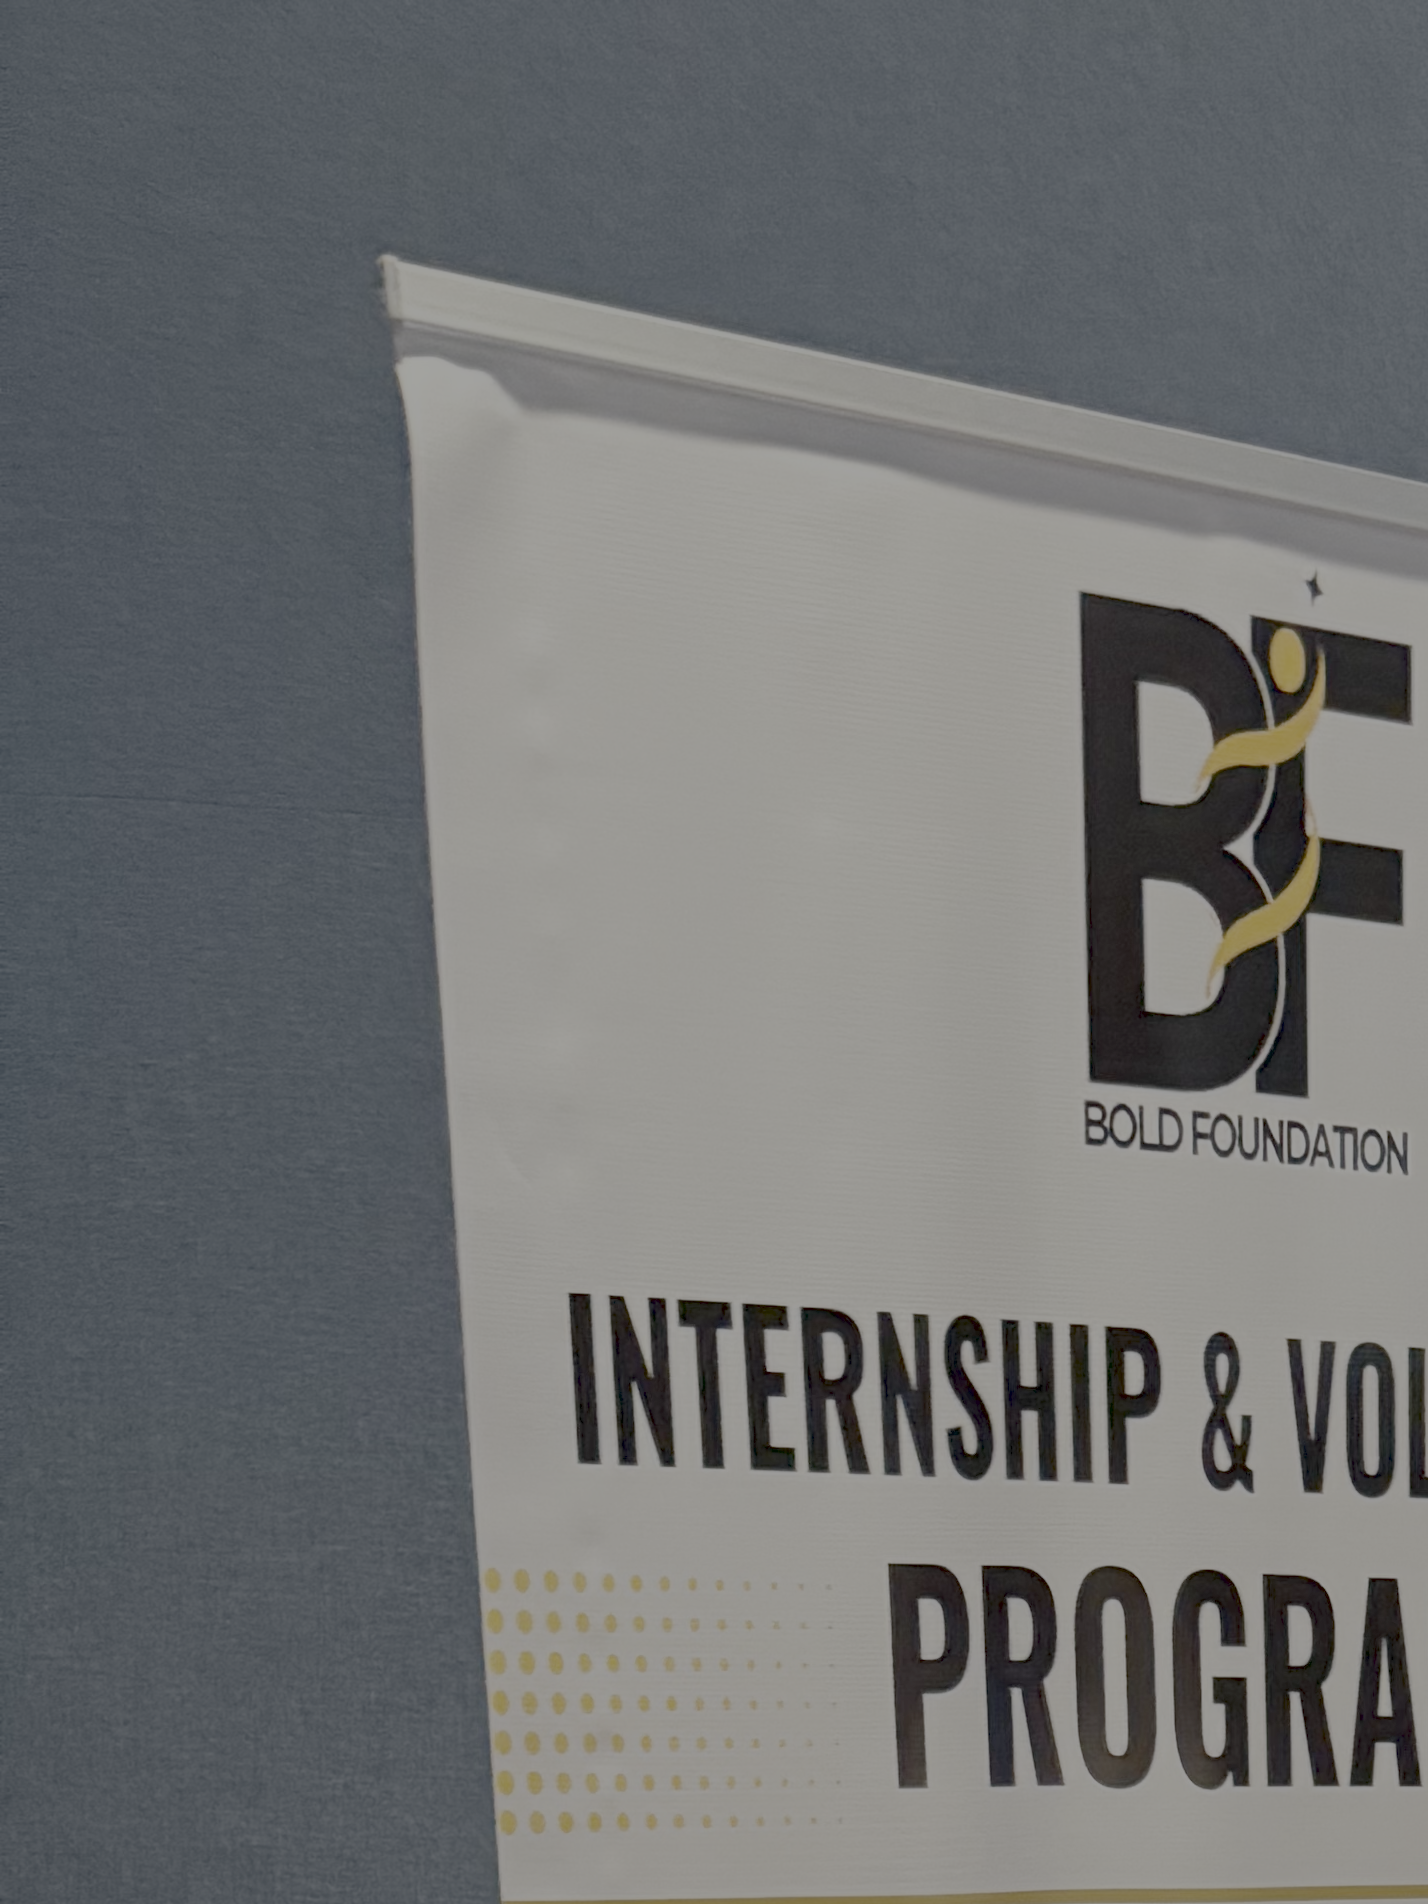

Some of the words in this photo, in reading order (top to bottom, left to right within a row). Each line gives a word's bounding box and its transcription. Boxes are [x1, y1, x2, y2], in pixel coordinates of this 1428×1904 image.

[1080, 591, 1412, 1098] BF
[1082, 1101, 1184, 1155] BOLD
[1192, 1112, 1409, 1176] FOUNDATION
[568, 1291, 1162, 1486] INTERNSHIP
[1200, 1331, 1255, 1495] &
